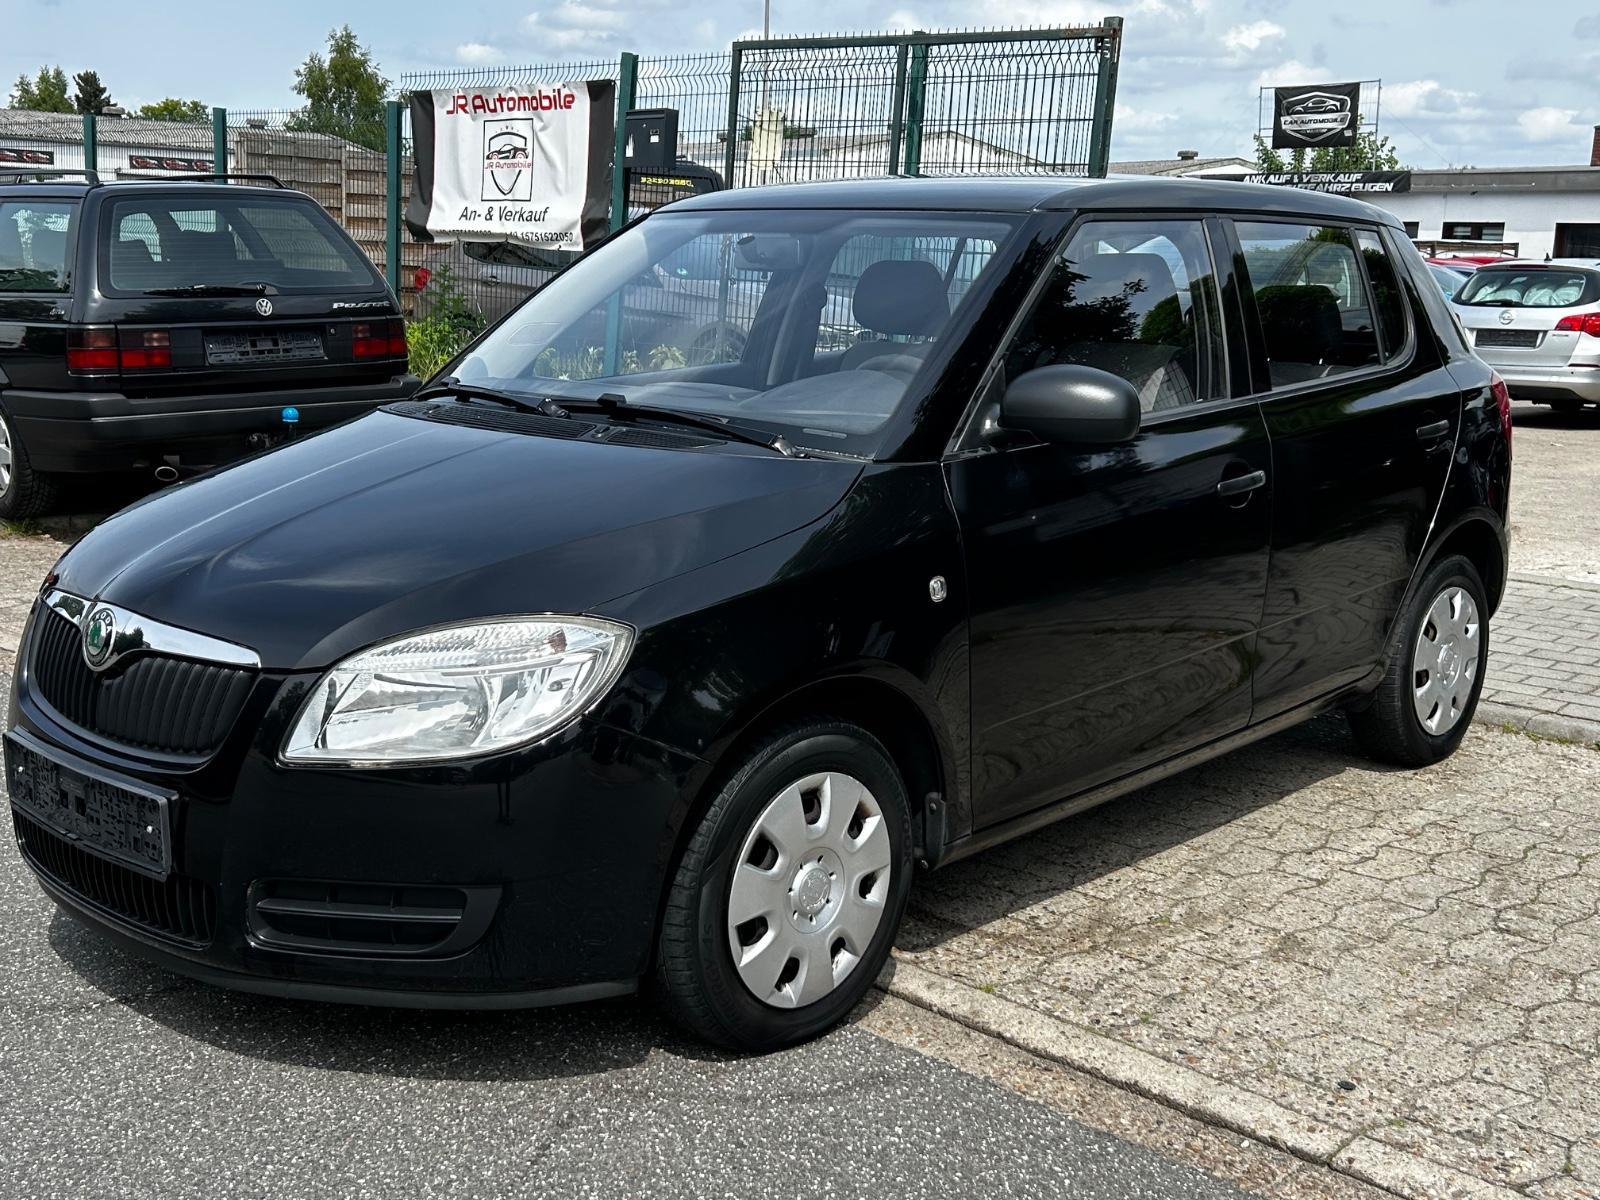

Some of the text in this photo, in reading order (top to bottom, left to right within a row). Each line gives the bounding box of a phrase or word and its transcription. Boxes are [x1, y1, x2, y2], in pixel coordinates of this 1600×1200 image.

[446, 88, 575, 114] JR Automobile
[484, 160, 531, 169] JR Automobile
[1243, 174, 1291, 184] ANKAUF
[1302, 173, 1363, 183] VERKAUF
[458, 205, 550, 222] An- & Verkauf
